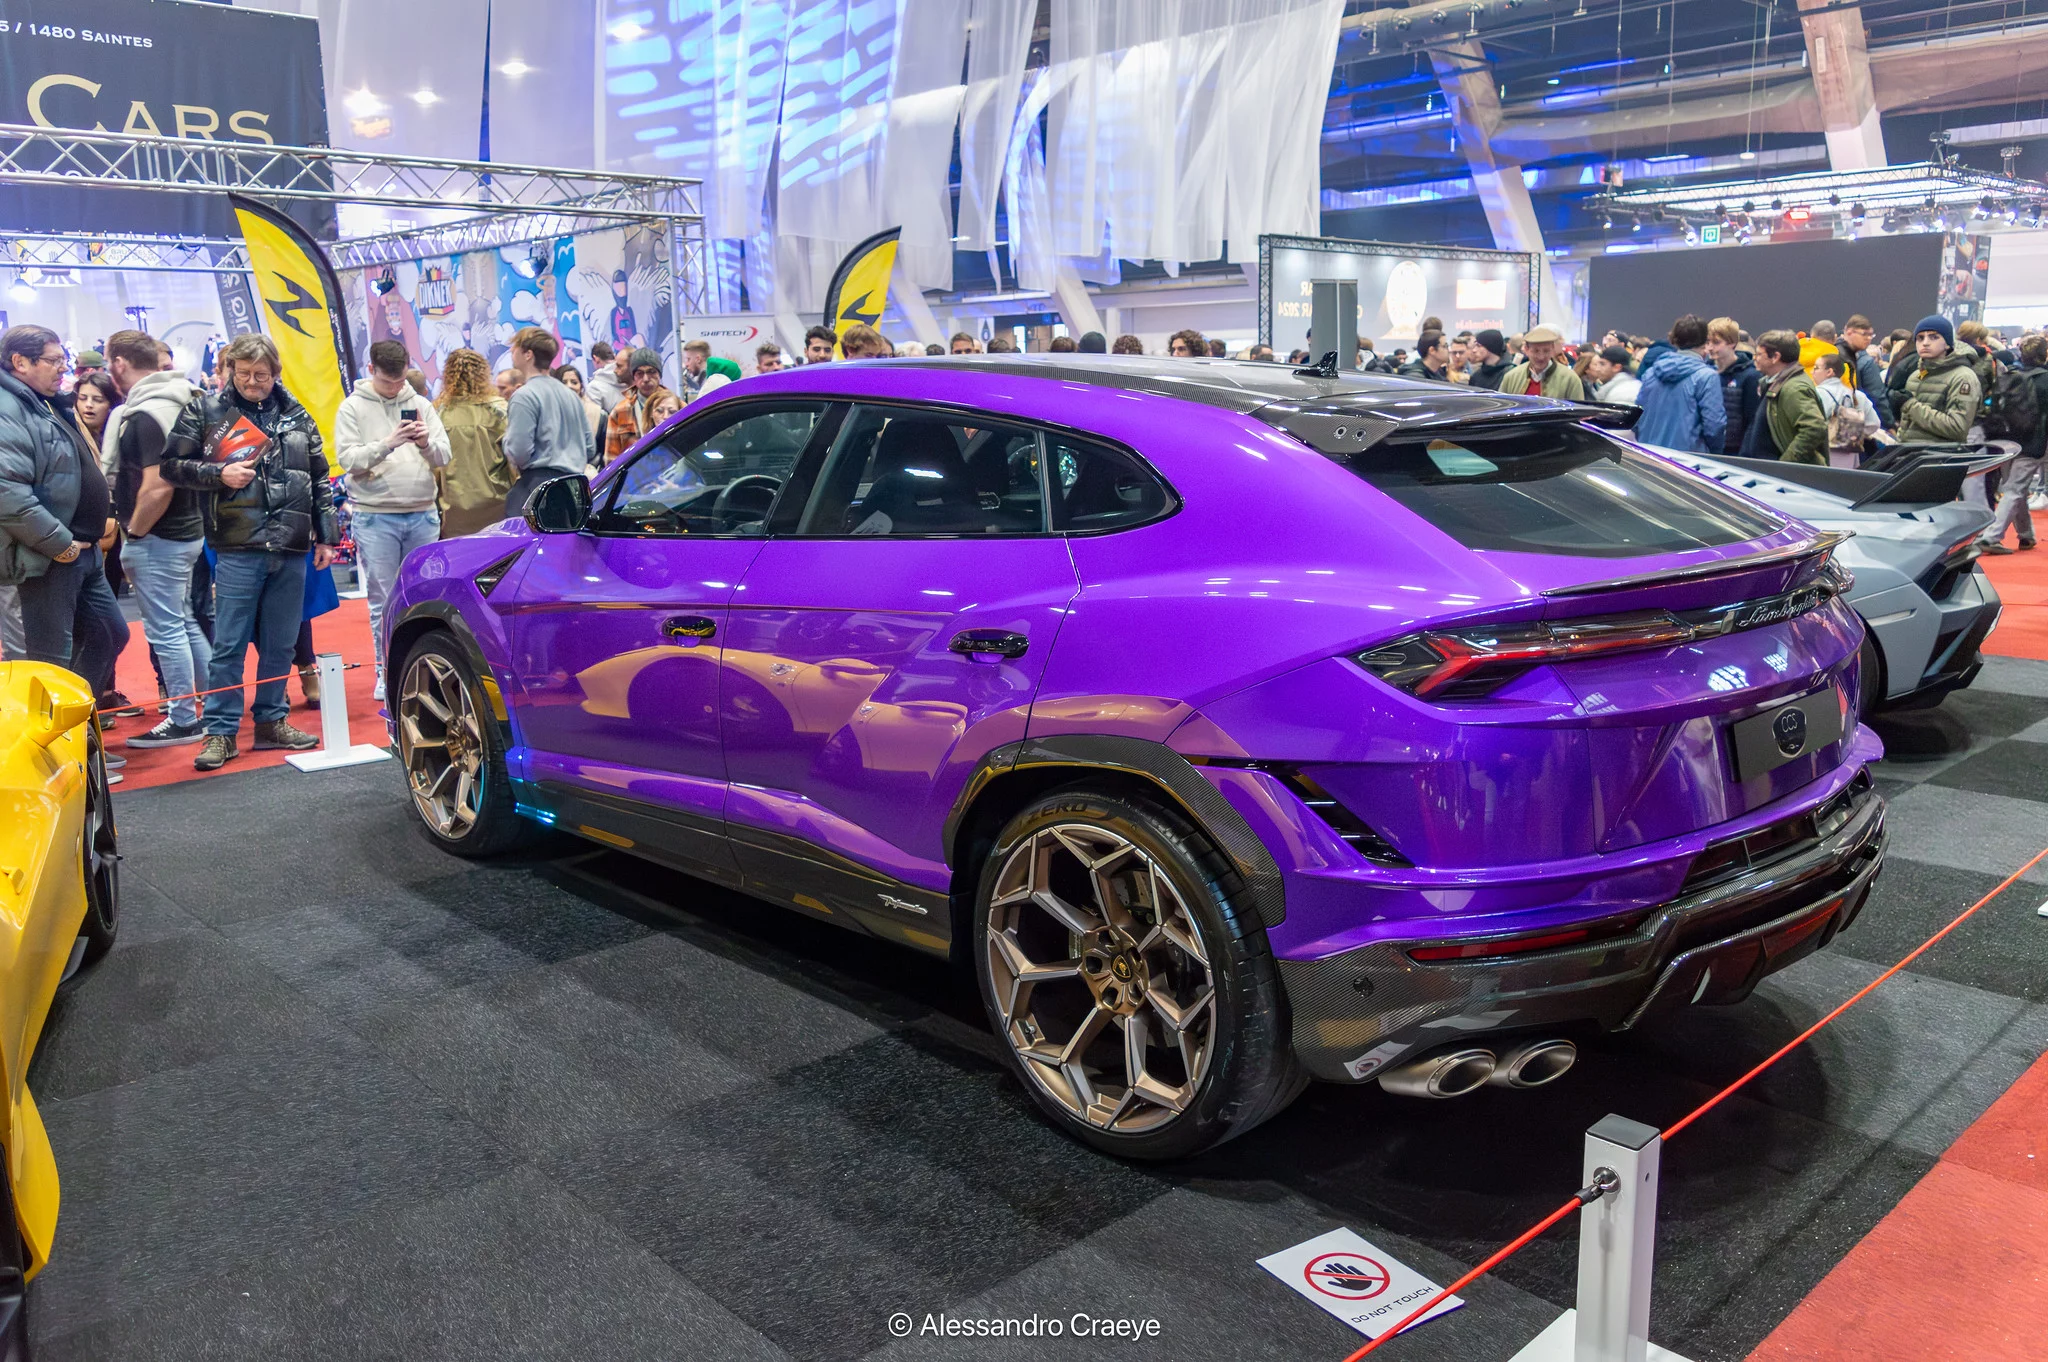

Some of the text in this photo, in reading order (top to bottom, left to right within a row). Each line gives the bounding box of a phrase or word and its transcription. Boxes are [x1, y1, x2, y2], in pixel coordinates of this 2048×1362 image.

[29, 23, 76, 39] 1480
[81, 30, 153, 48] SAINTES
[1781, 712, 1798, 733] CCS
[1351, 1286, 1434, 1324] DO NOT TOUCH
